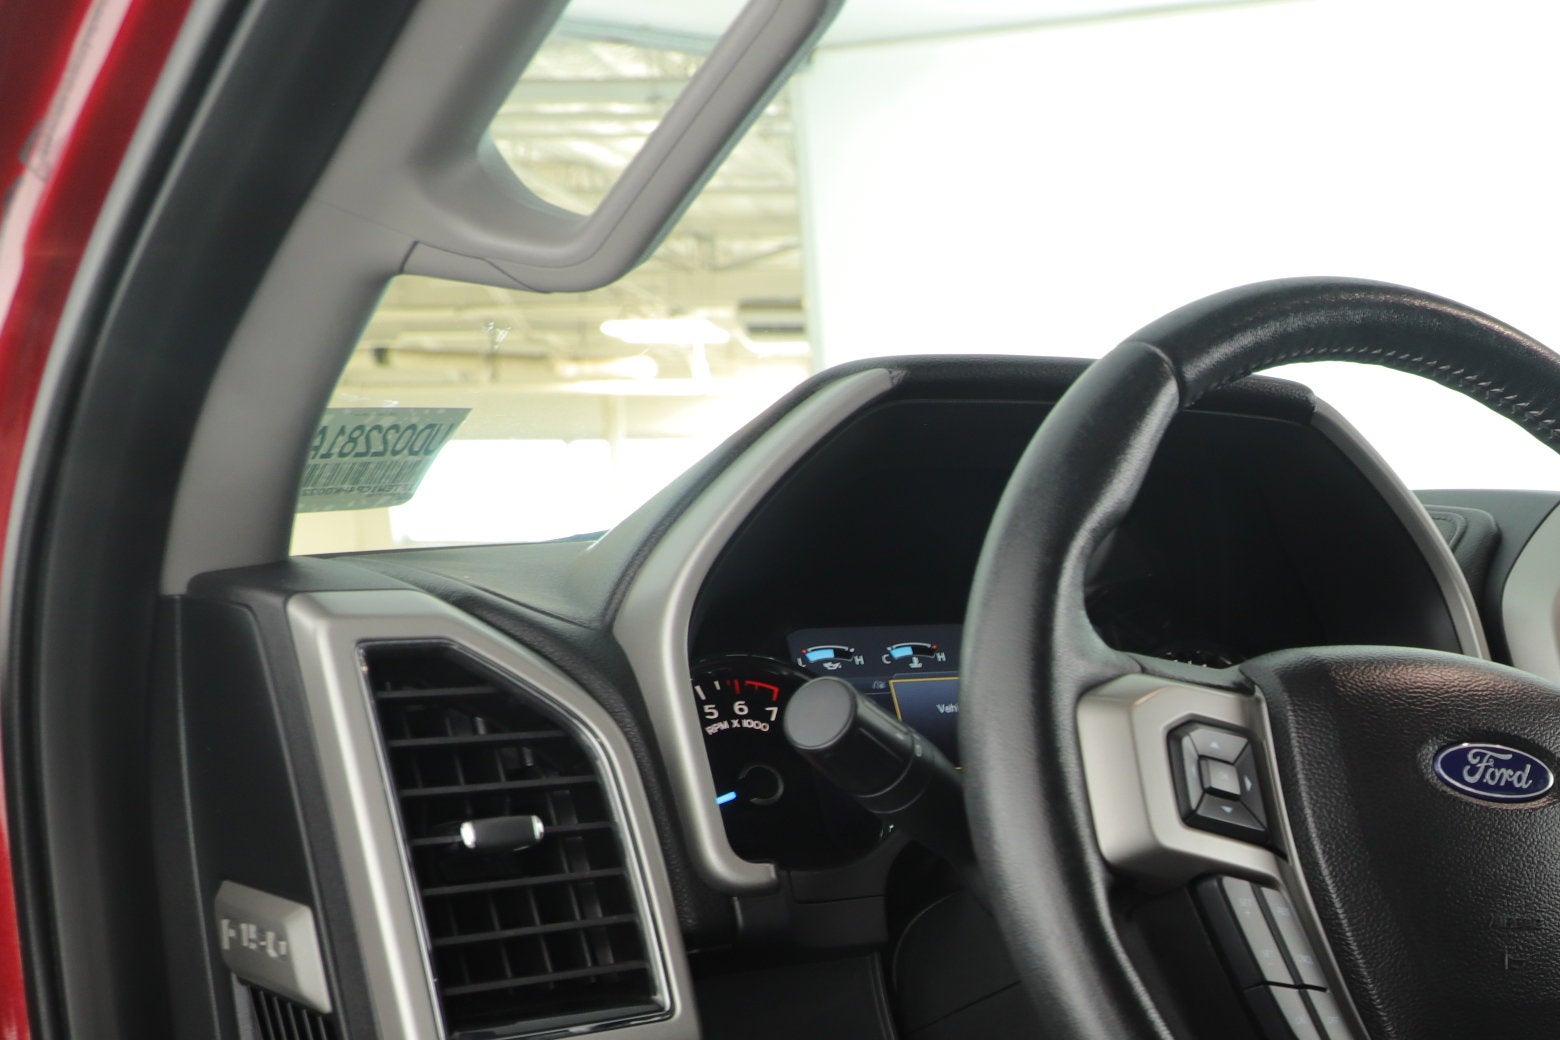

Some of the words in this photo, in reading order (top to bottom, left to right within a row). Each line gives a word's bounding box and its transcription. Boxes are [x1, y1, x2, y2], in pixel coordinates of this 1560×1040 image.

[853, 655, 865, 666] H
[881, 653, 891, 665] C
[936, 651, 946, 662] H
[703, 704, 719, 720] 5
[733, 700, 749, 716] 6
[764, 706, 779, 722] 7
[705, 720, 730, 736] RPM
[742, 718, 770, 732] 1000
[1462, 748, 1533, 789] Ford
